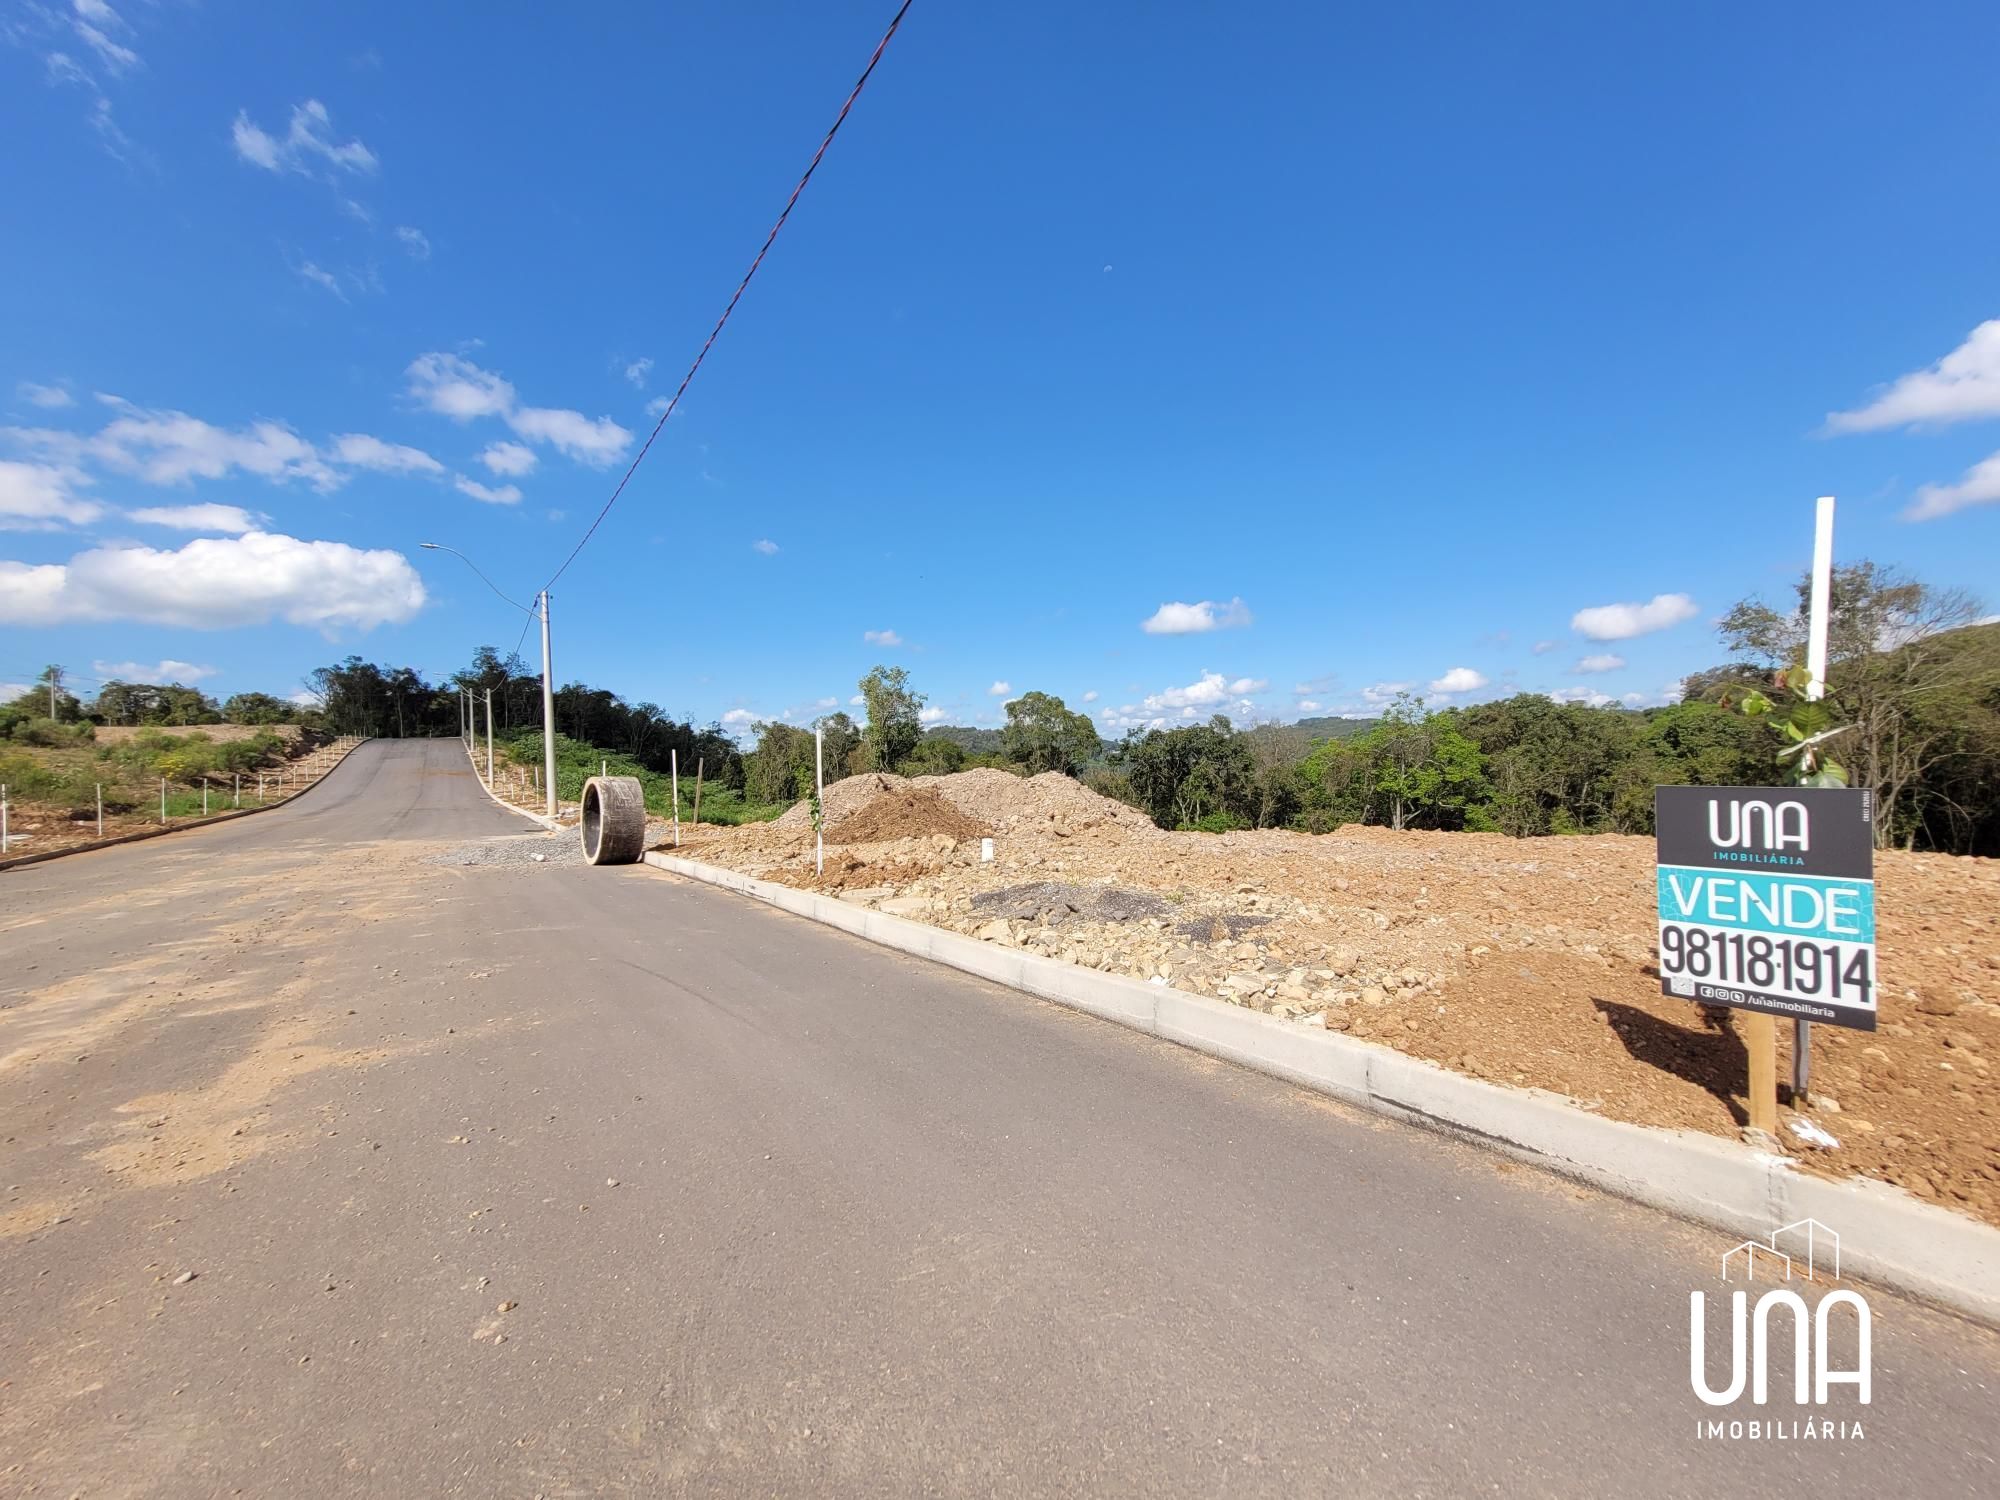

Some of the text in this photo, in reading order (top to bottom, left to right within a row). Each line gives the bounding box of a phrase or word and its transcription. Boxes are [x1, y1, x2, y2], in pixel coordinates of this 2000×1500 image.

[1708, 800, 1809, 851] UNA
[1713, 852, 1805, 865] IMOBILIÁRIA
[1668, 874, 1860, 934] VENDE
